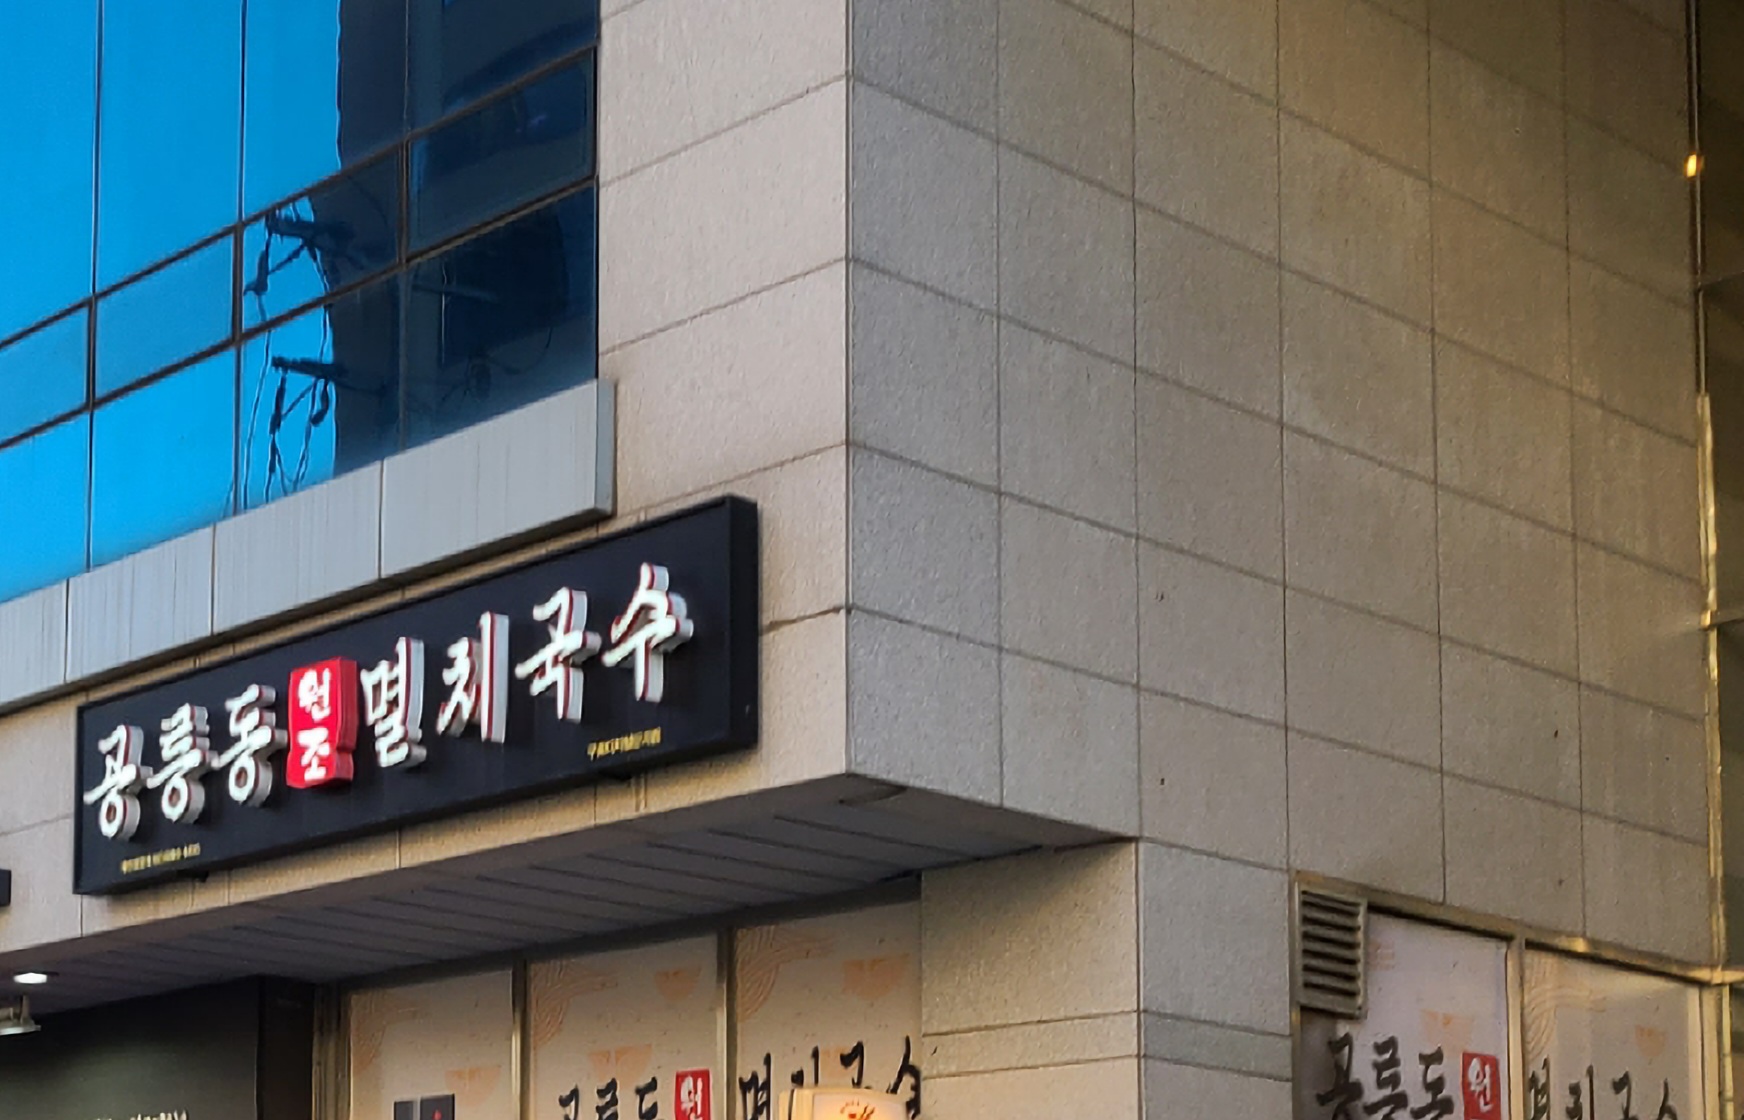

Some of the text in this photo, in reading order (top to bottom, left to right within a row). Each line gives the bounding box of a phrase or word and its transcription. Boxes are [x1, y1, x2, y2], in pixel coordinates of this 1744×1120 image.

[84, 563, 694, 841] 공릉동 원조 멸치국수
